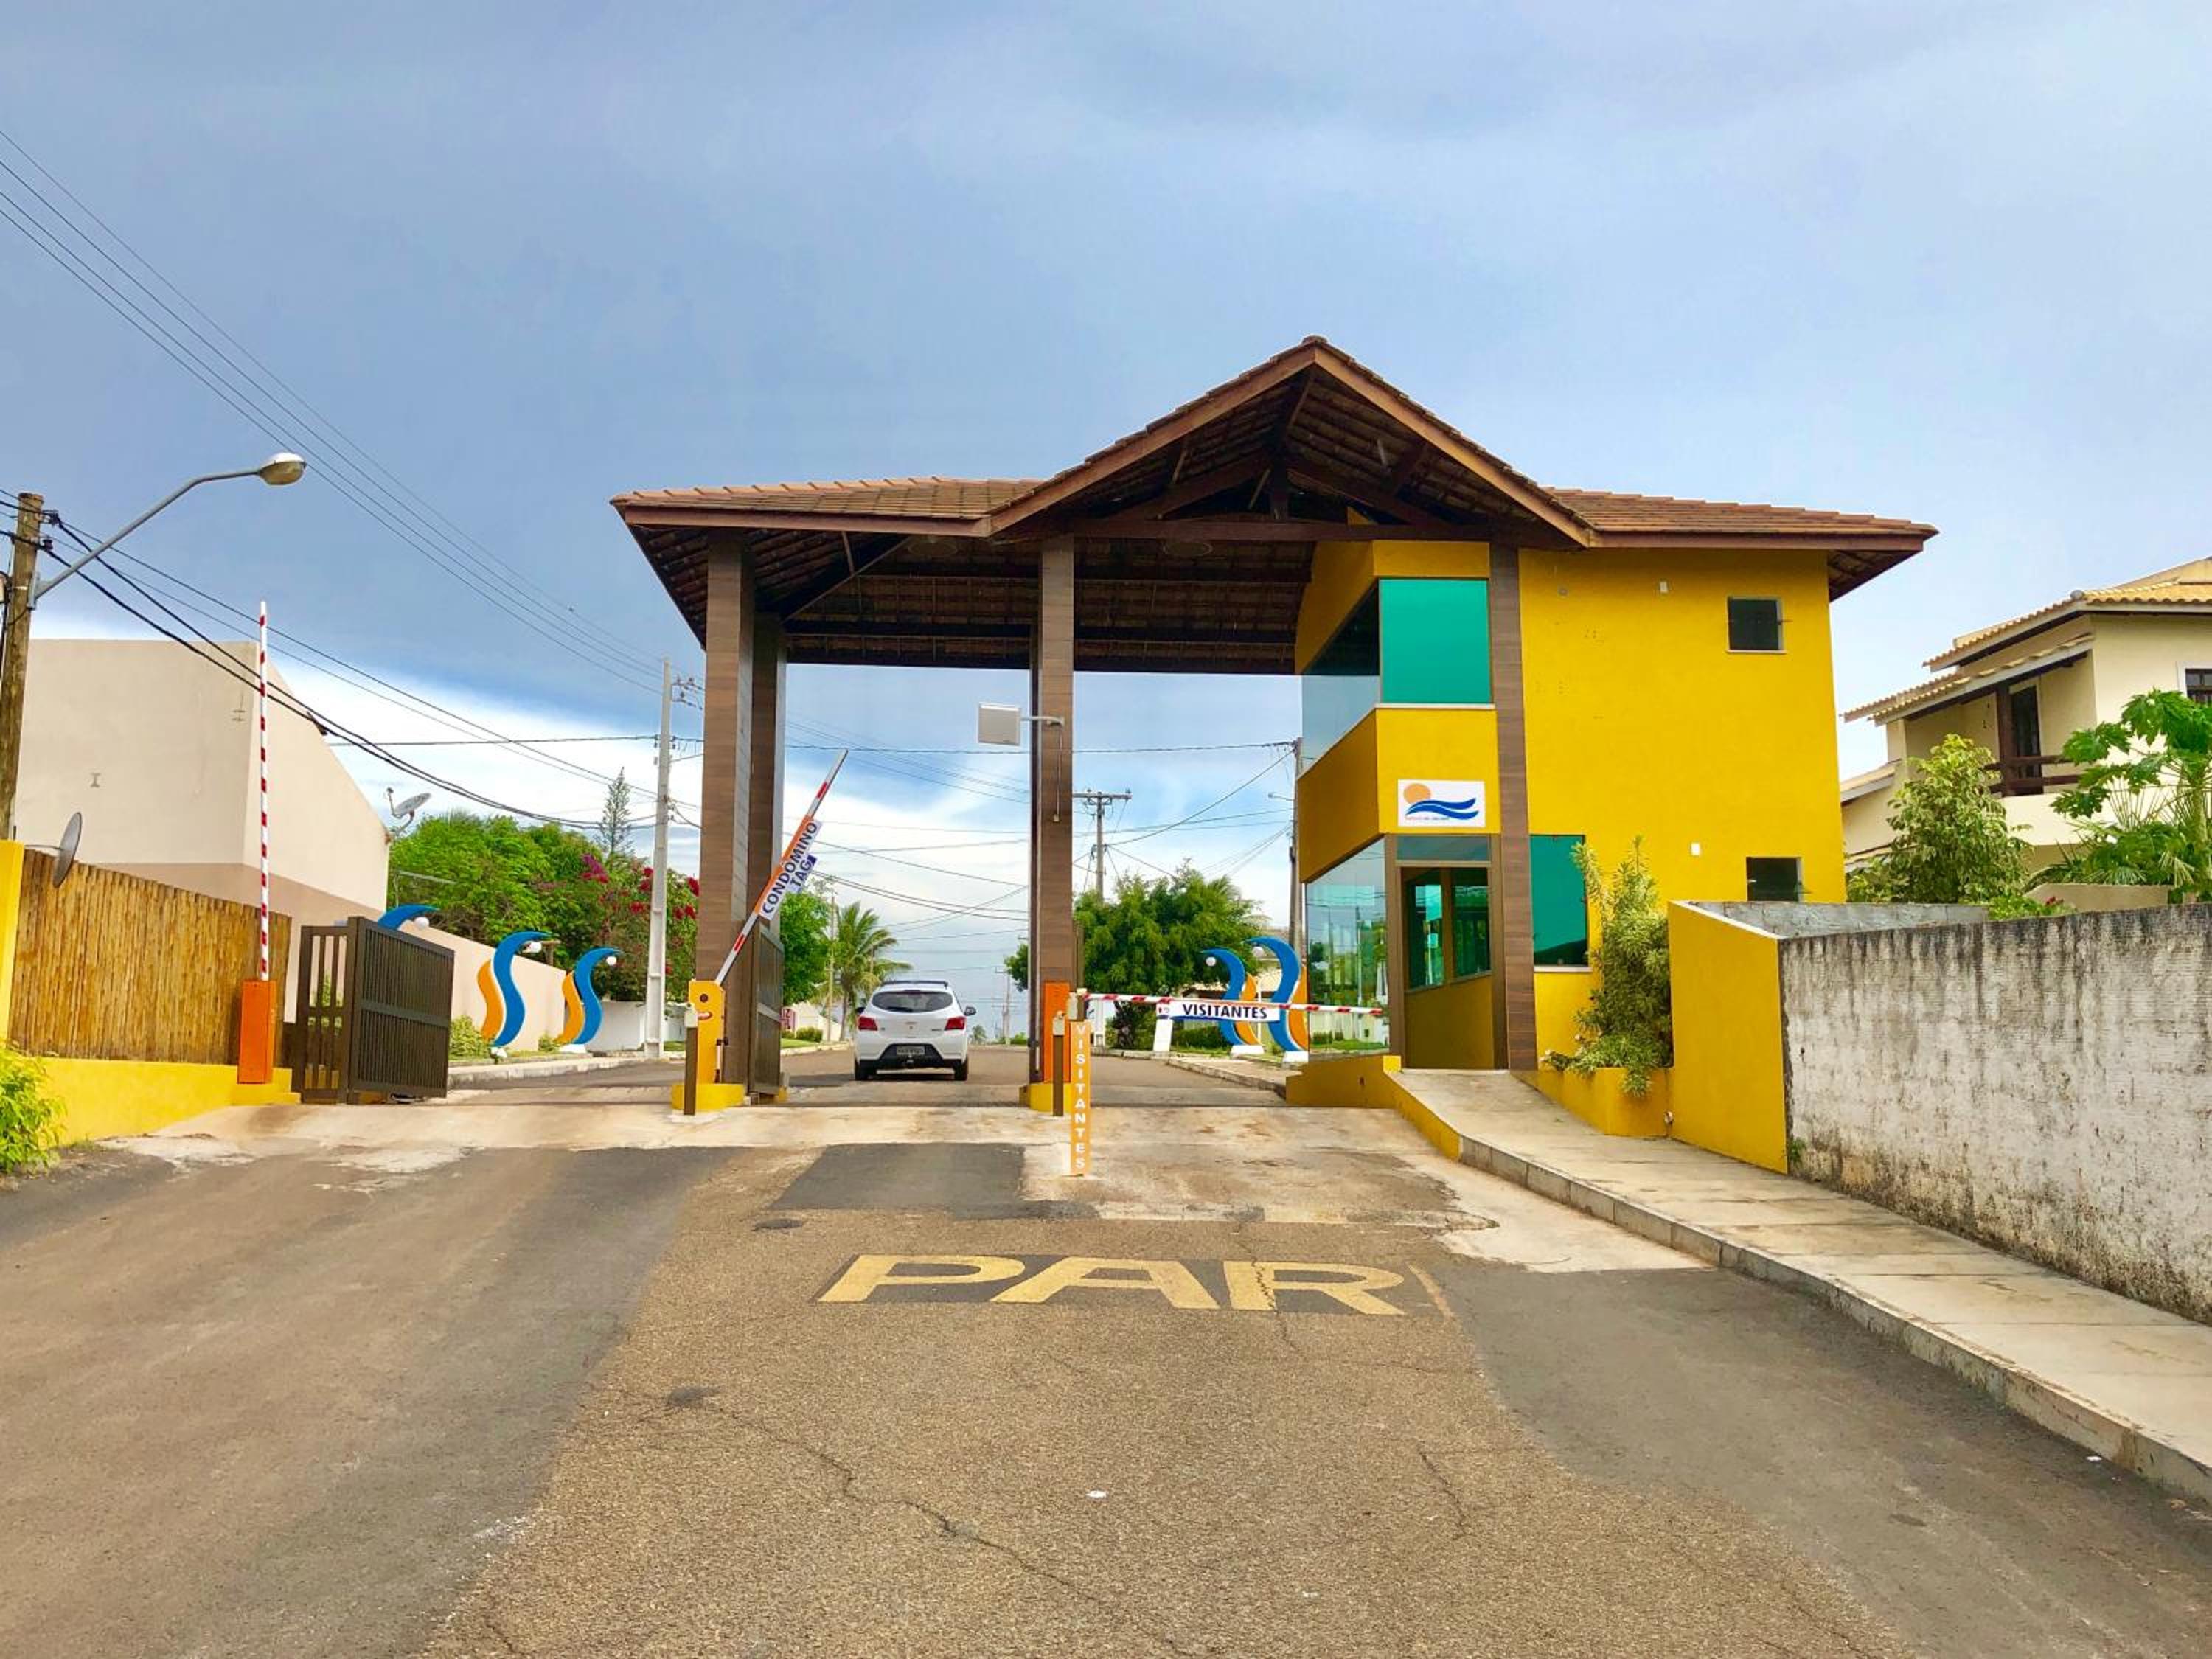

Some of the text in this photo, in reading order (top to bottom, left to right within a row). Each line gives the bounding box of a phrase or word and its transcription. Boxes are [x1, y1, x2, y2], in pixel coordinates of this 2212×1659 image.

[790, 859, 812, 887] TAG
[1182, 1004, 1267, 1019] VISITANTES
[1074, 1024, 1086, 1169] VISITANTES
[817, 1253, 1406, 1315] PAR
